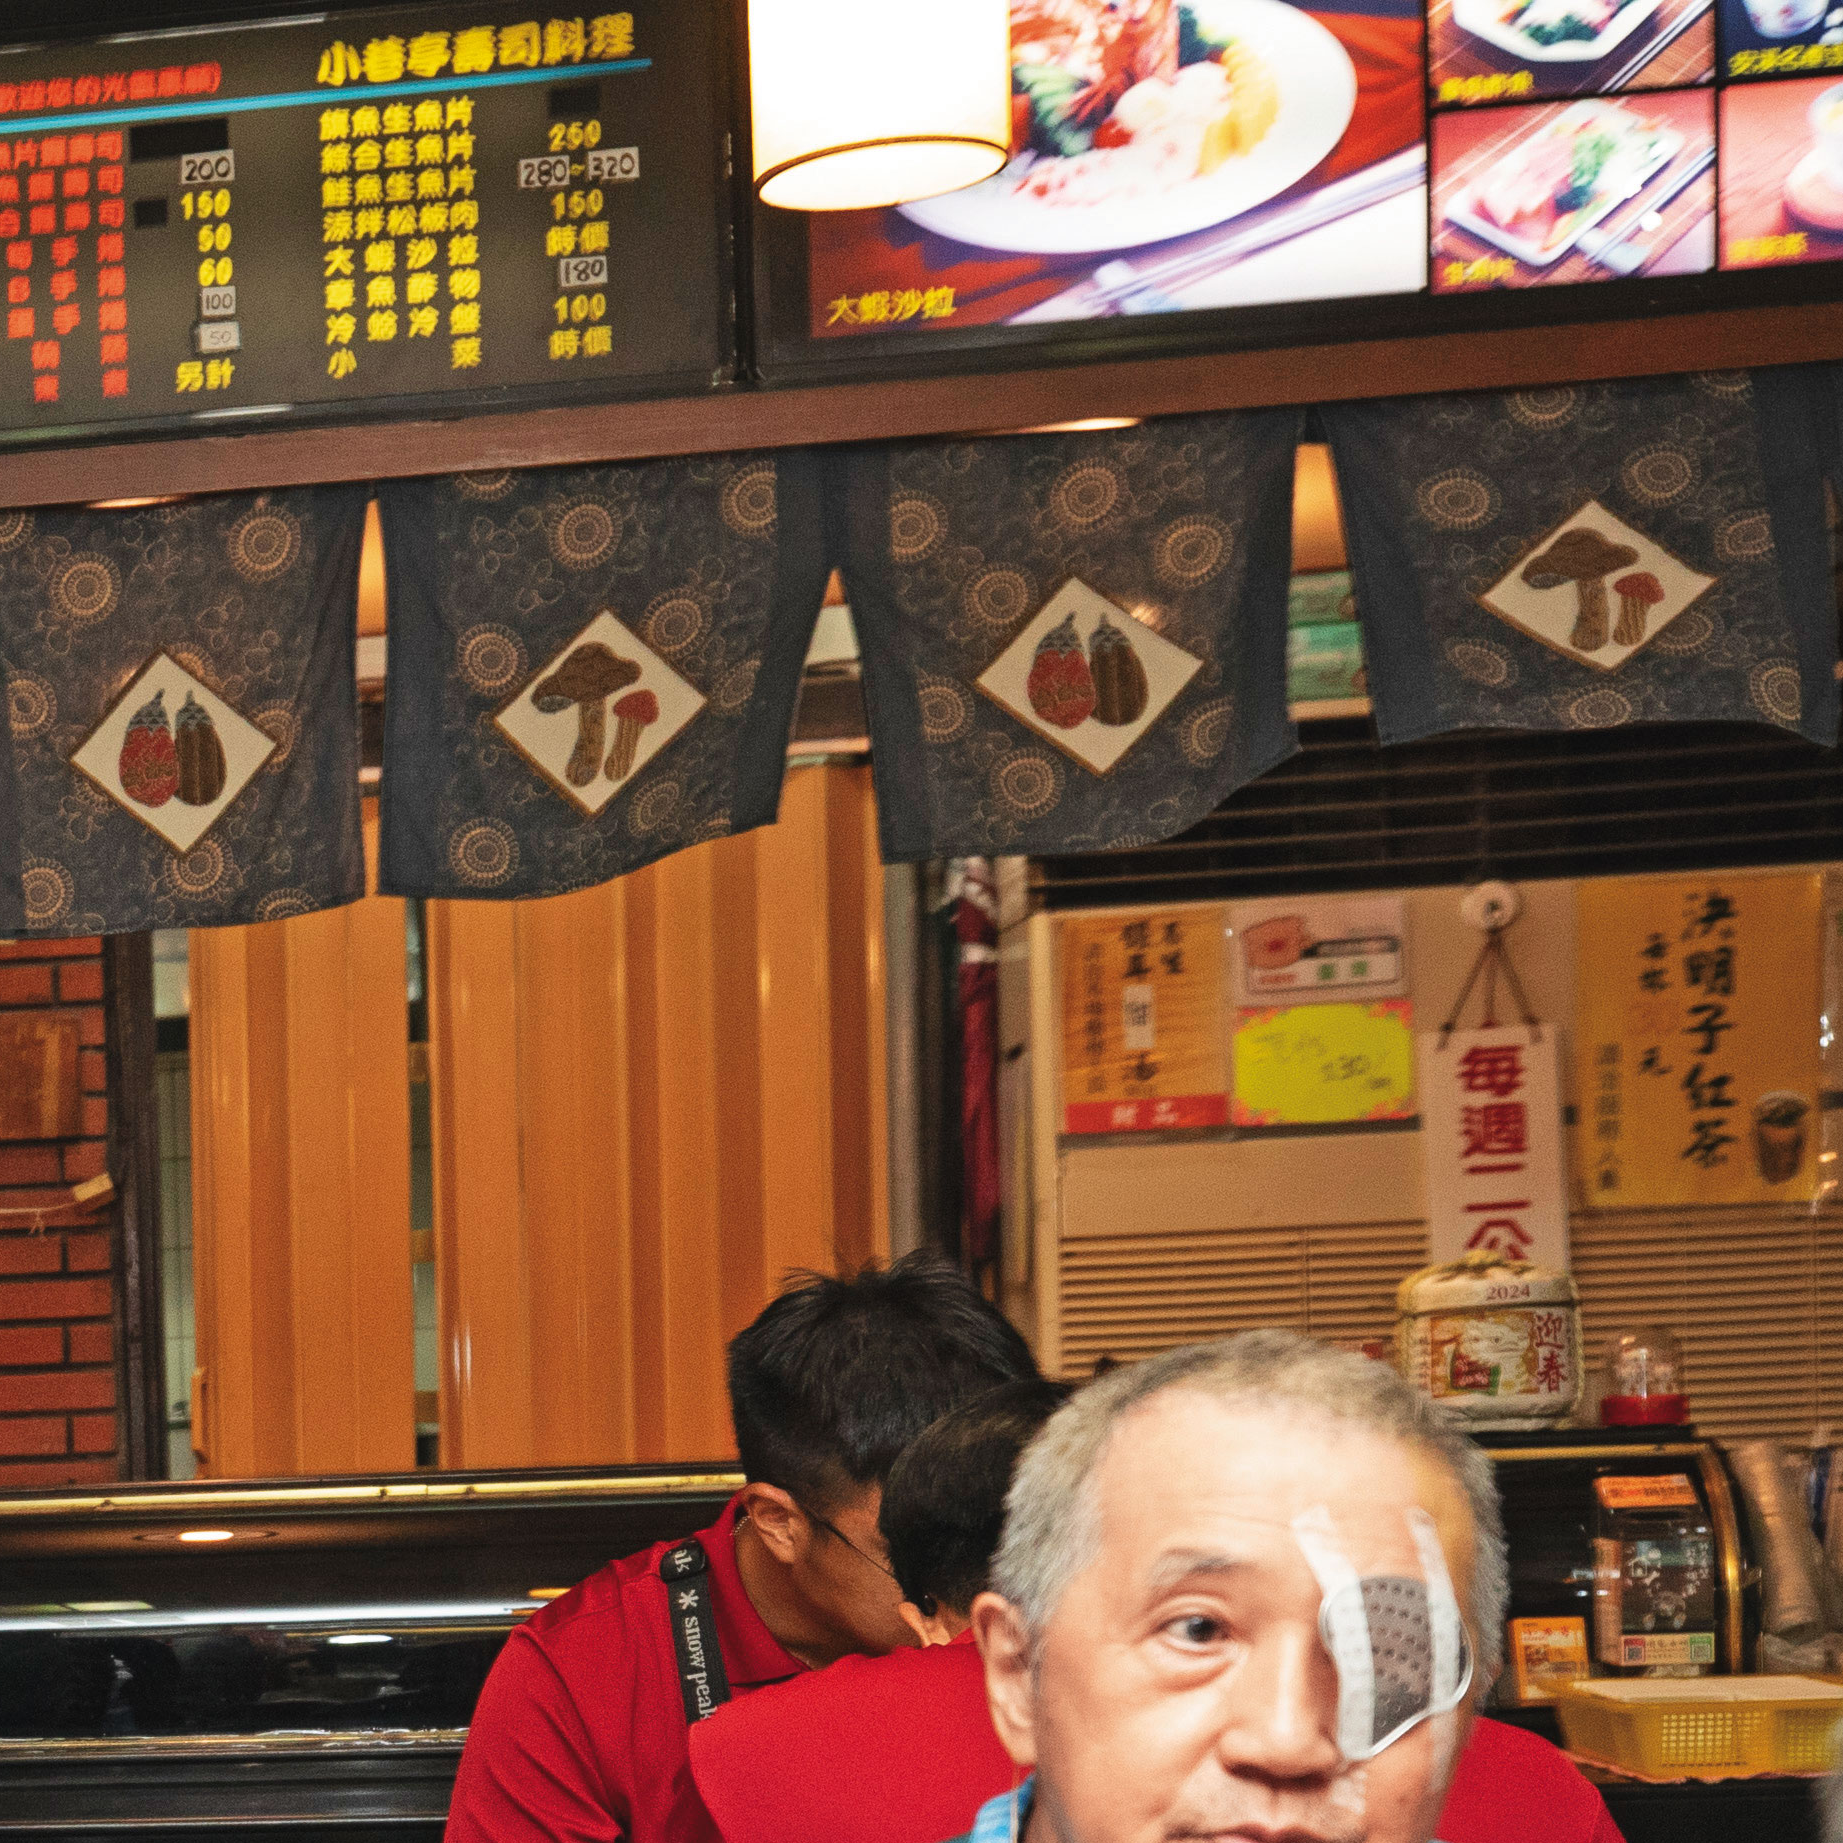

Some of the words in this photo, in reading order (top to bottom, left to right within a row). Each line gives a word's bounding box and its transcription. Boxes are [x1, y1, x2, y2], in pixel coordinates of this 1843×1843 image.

[548, 119, 602, 152] 250
[184, 156, 232, 182] 200
[181, 188, 232, 221] 150
[551, 188, 604, 221] 150
[198, 256, 234, 287] 60
[564, 259, 606, 285] 180
[204, 292, 233, 310] 100
[553, 292, 606, 324] 100
[1487, 1284, 1531, 1301] 2024
[1533, 1311, 1567, 1396] 迎春
[685, 1615, 706, 1669] snow
